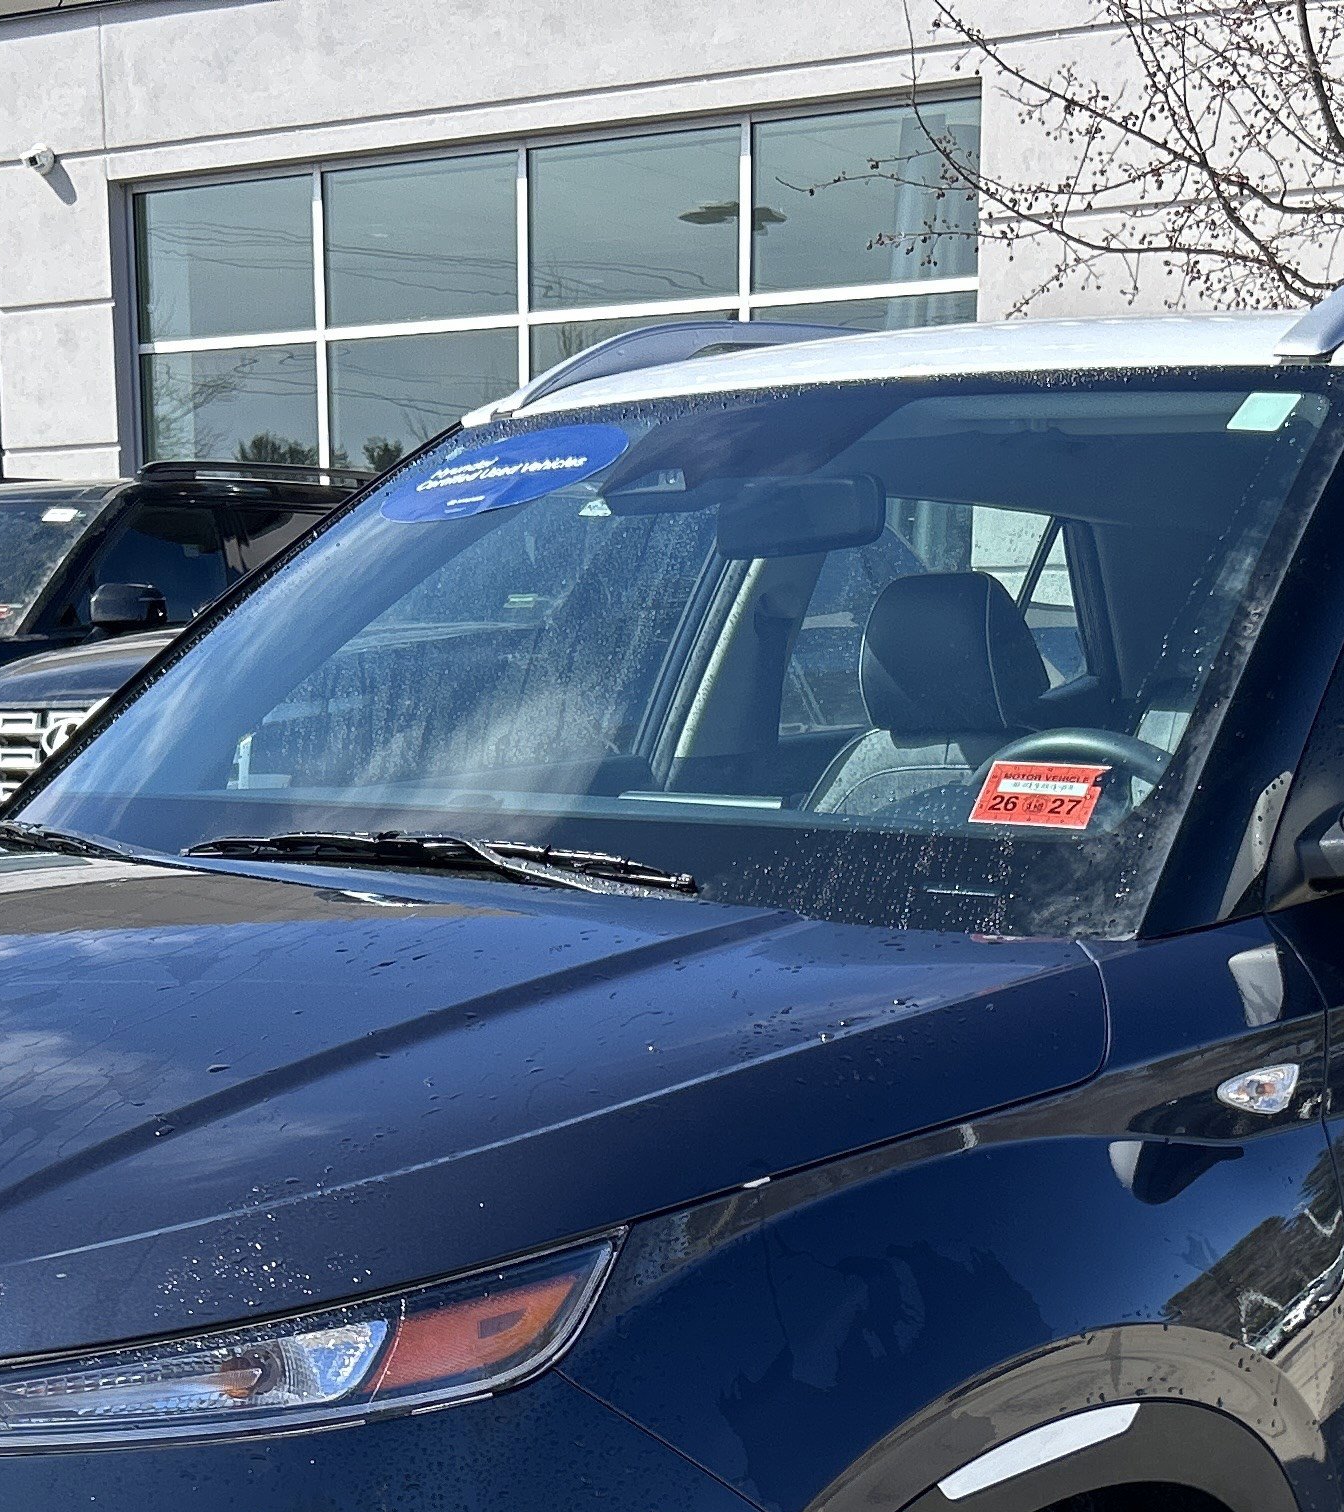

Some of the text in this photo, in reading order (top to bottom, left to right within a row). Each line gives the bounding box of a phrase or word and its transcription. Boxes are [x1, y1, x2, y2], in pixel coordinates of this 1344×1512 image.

[1003, 772, 1089, 783] MOTOR VEHICLE
[987, 794, 1020, 812] 26
[1047, 798, 1083, 815] 27
